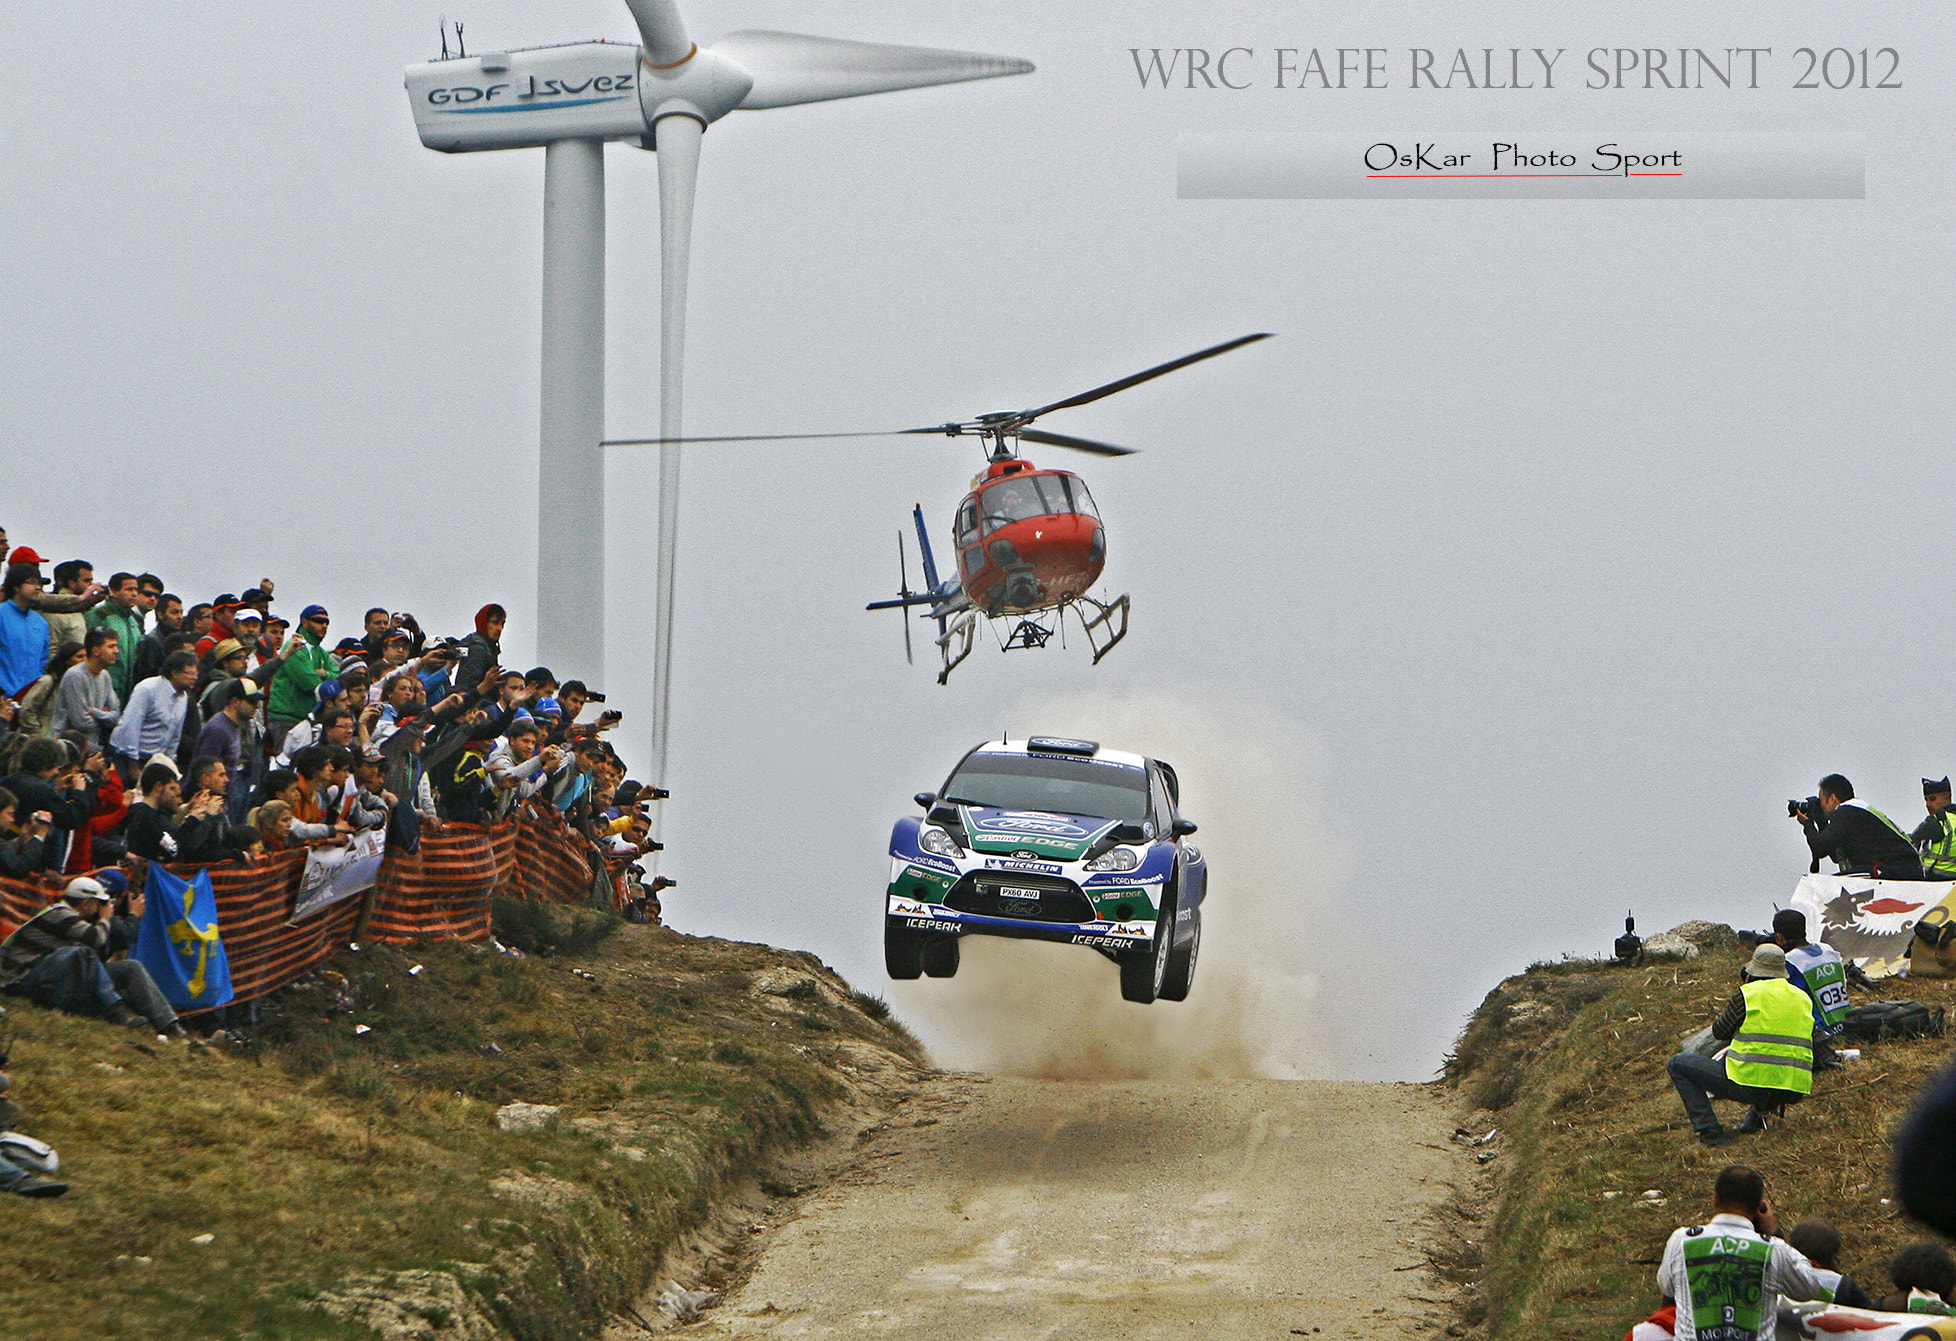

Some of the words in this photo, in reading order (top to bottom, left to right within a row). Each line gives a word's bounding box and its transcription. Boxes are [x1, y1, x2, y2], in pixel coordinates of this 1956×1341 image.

[428, 84, 509, 104] GDF
[998, 818, 1068, 833] Ford
[1020, 836, 1080, 850] EDGE
[1004, 861, 1059, 872] MICHELIN
[1112, 877, 1130, 885] FORD
[1002, 888, 1022, 897] PX60
[906, 918, 962, 933] ICEPEAK
[1071, 934, 1134, 949] ICEPEAK
